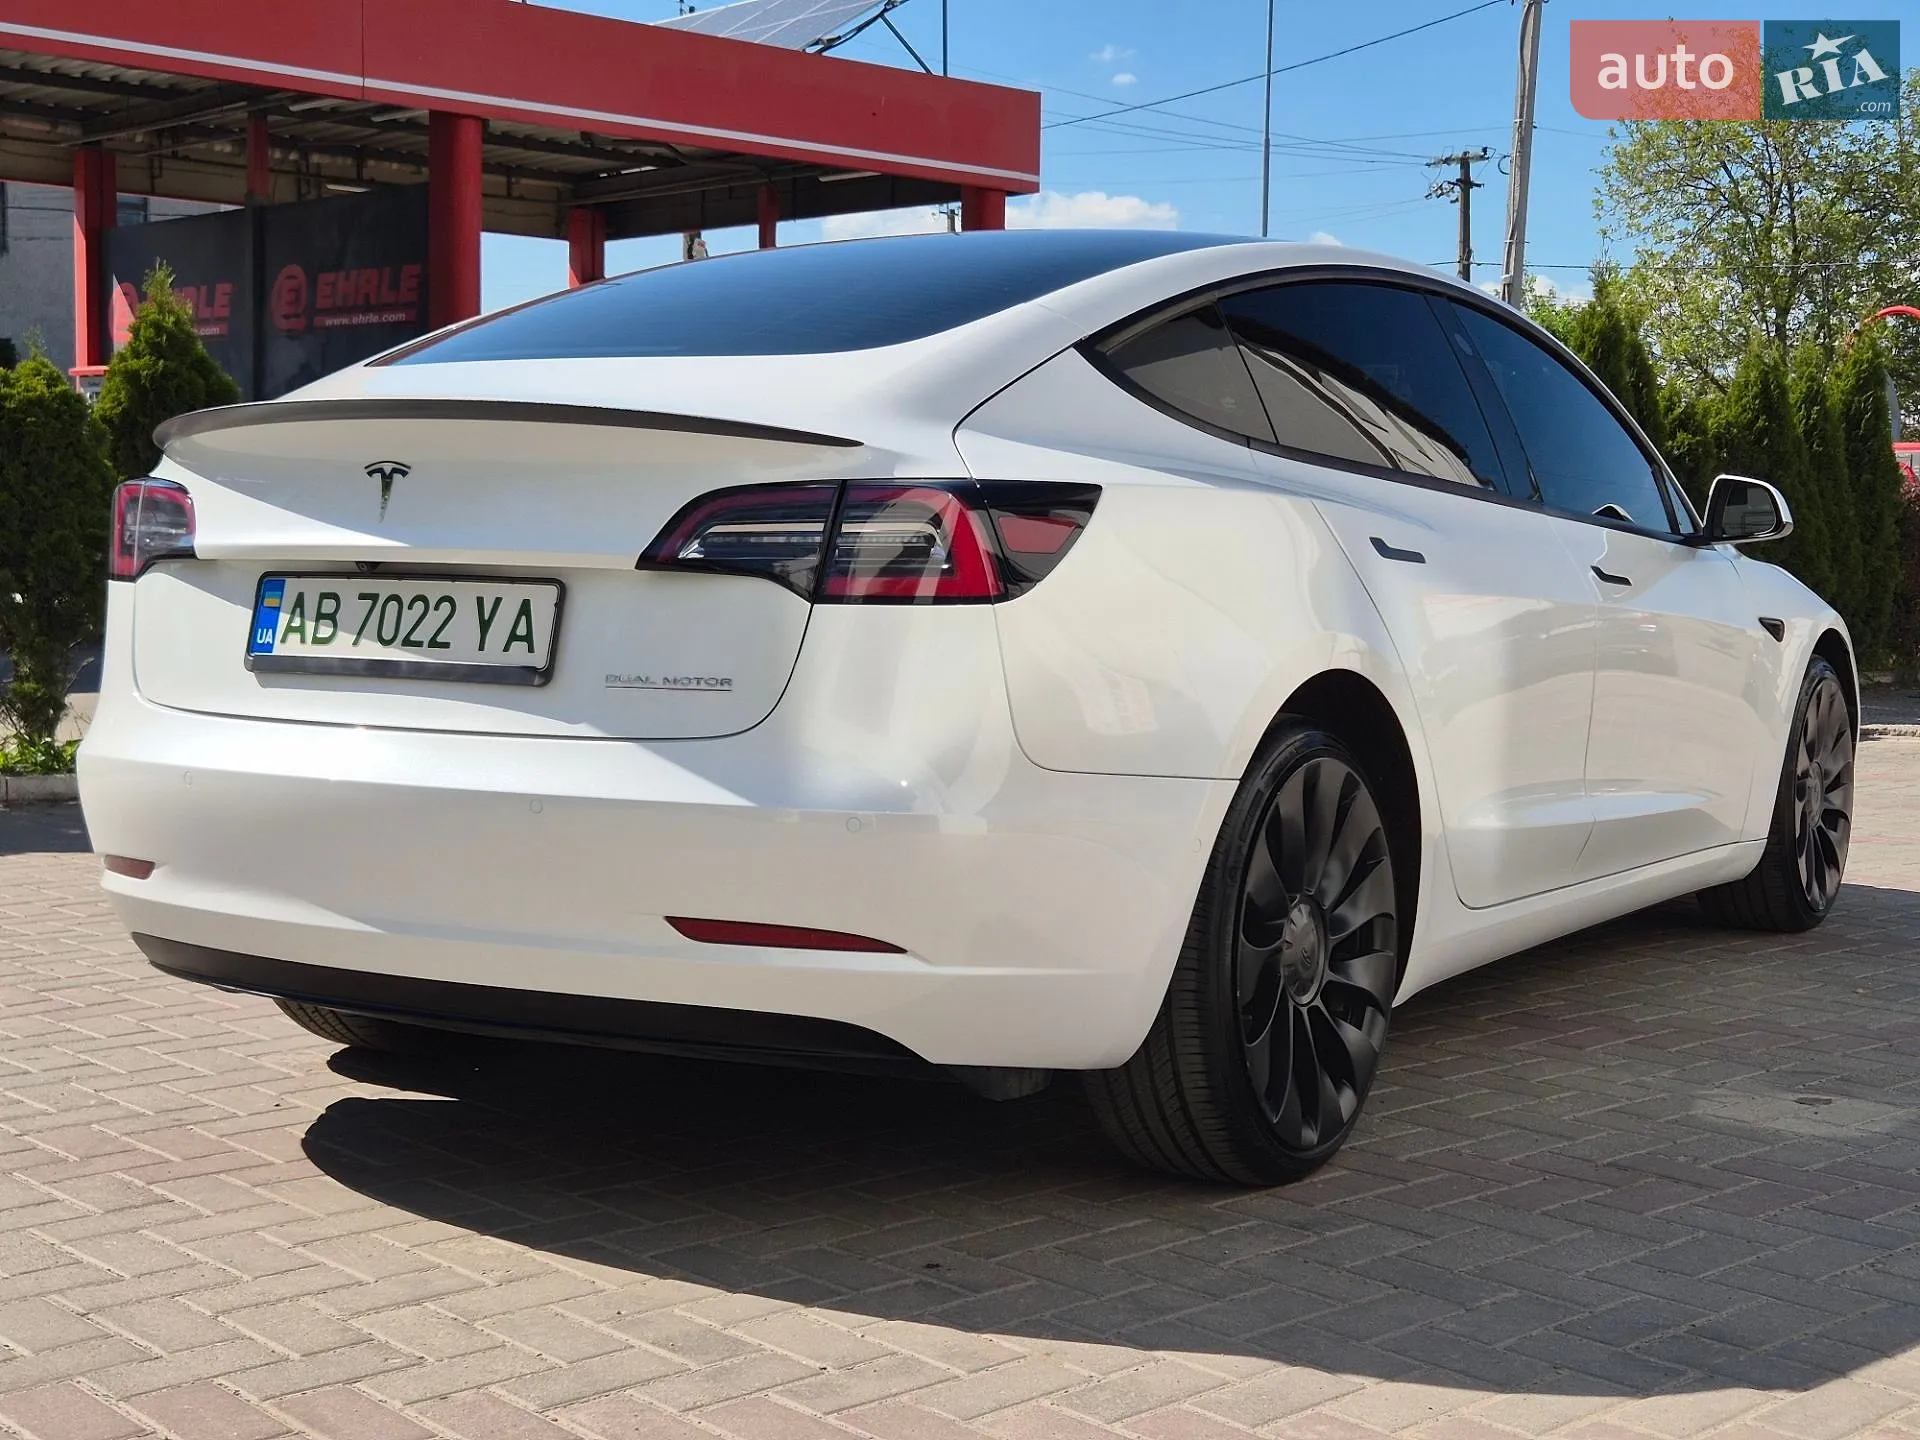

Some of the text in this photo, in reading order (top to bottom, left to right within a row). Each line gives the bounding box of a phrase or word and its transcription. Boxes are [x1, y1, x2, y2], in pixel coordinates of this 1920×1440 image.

[316, 264, 422, 309] EHRLE
[324, 311, 407, 327] www.ehrle.com
[280, 591, 536, 653] AB 7022 YA
[256, 628, 274, 644] UA
[605, 674, 733, 687] DUAL MOTOR
